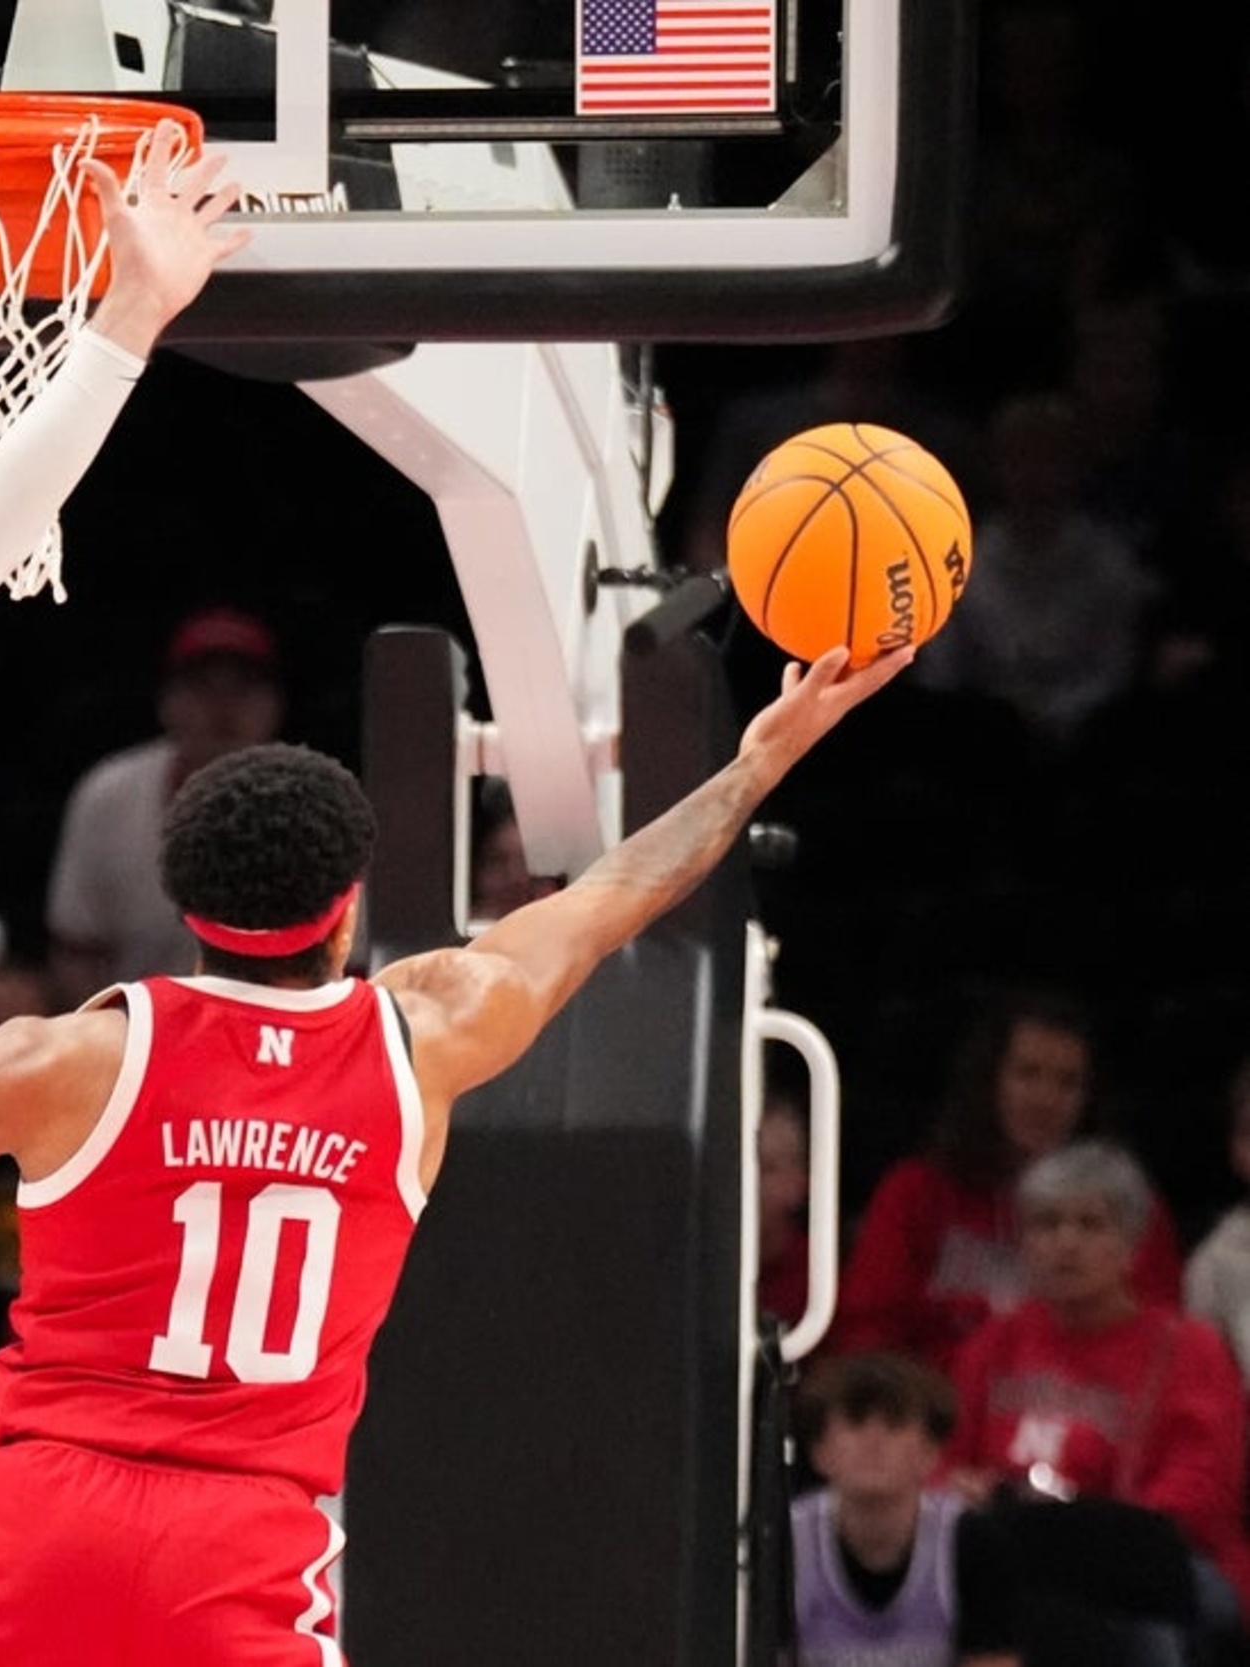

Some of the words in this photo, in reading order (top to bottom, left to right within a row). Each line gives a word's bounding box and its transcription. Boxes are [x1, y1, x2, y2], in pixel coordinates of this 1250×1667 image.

[256, 1025, 295, 1066] N
[162, 1119, 367, 1184] LAWRENCE
[149, 1181, 342, 1384] 10
